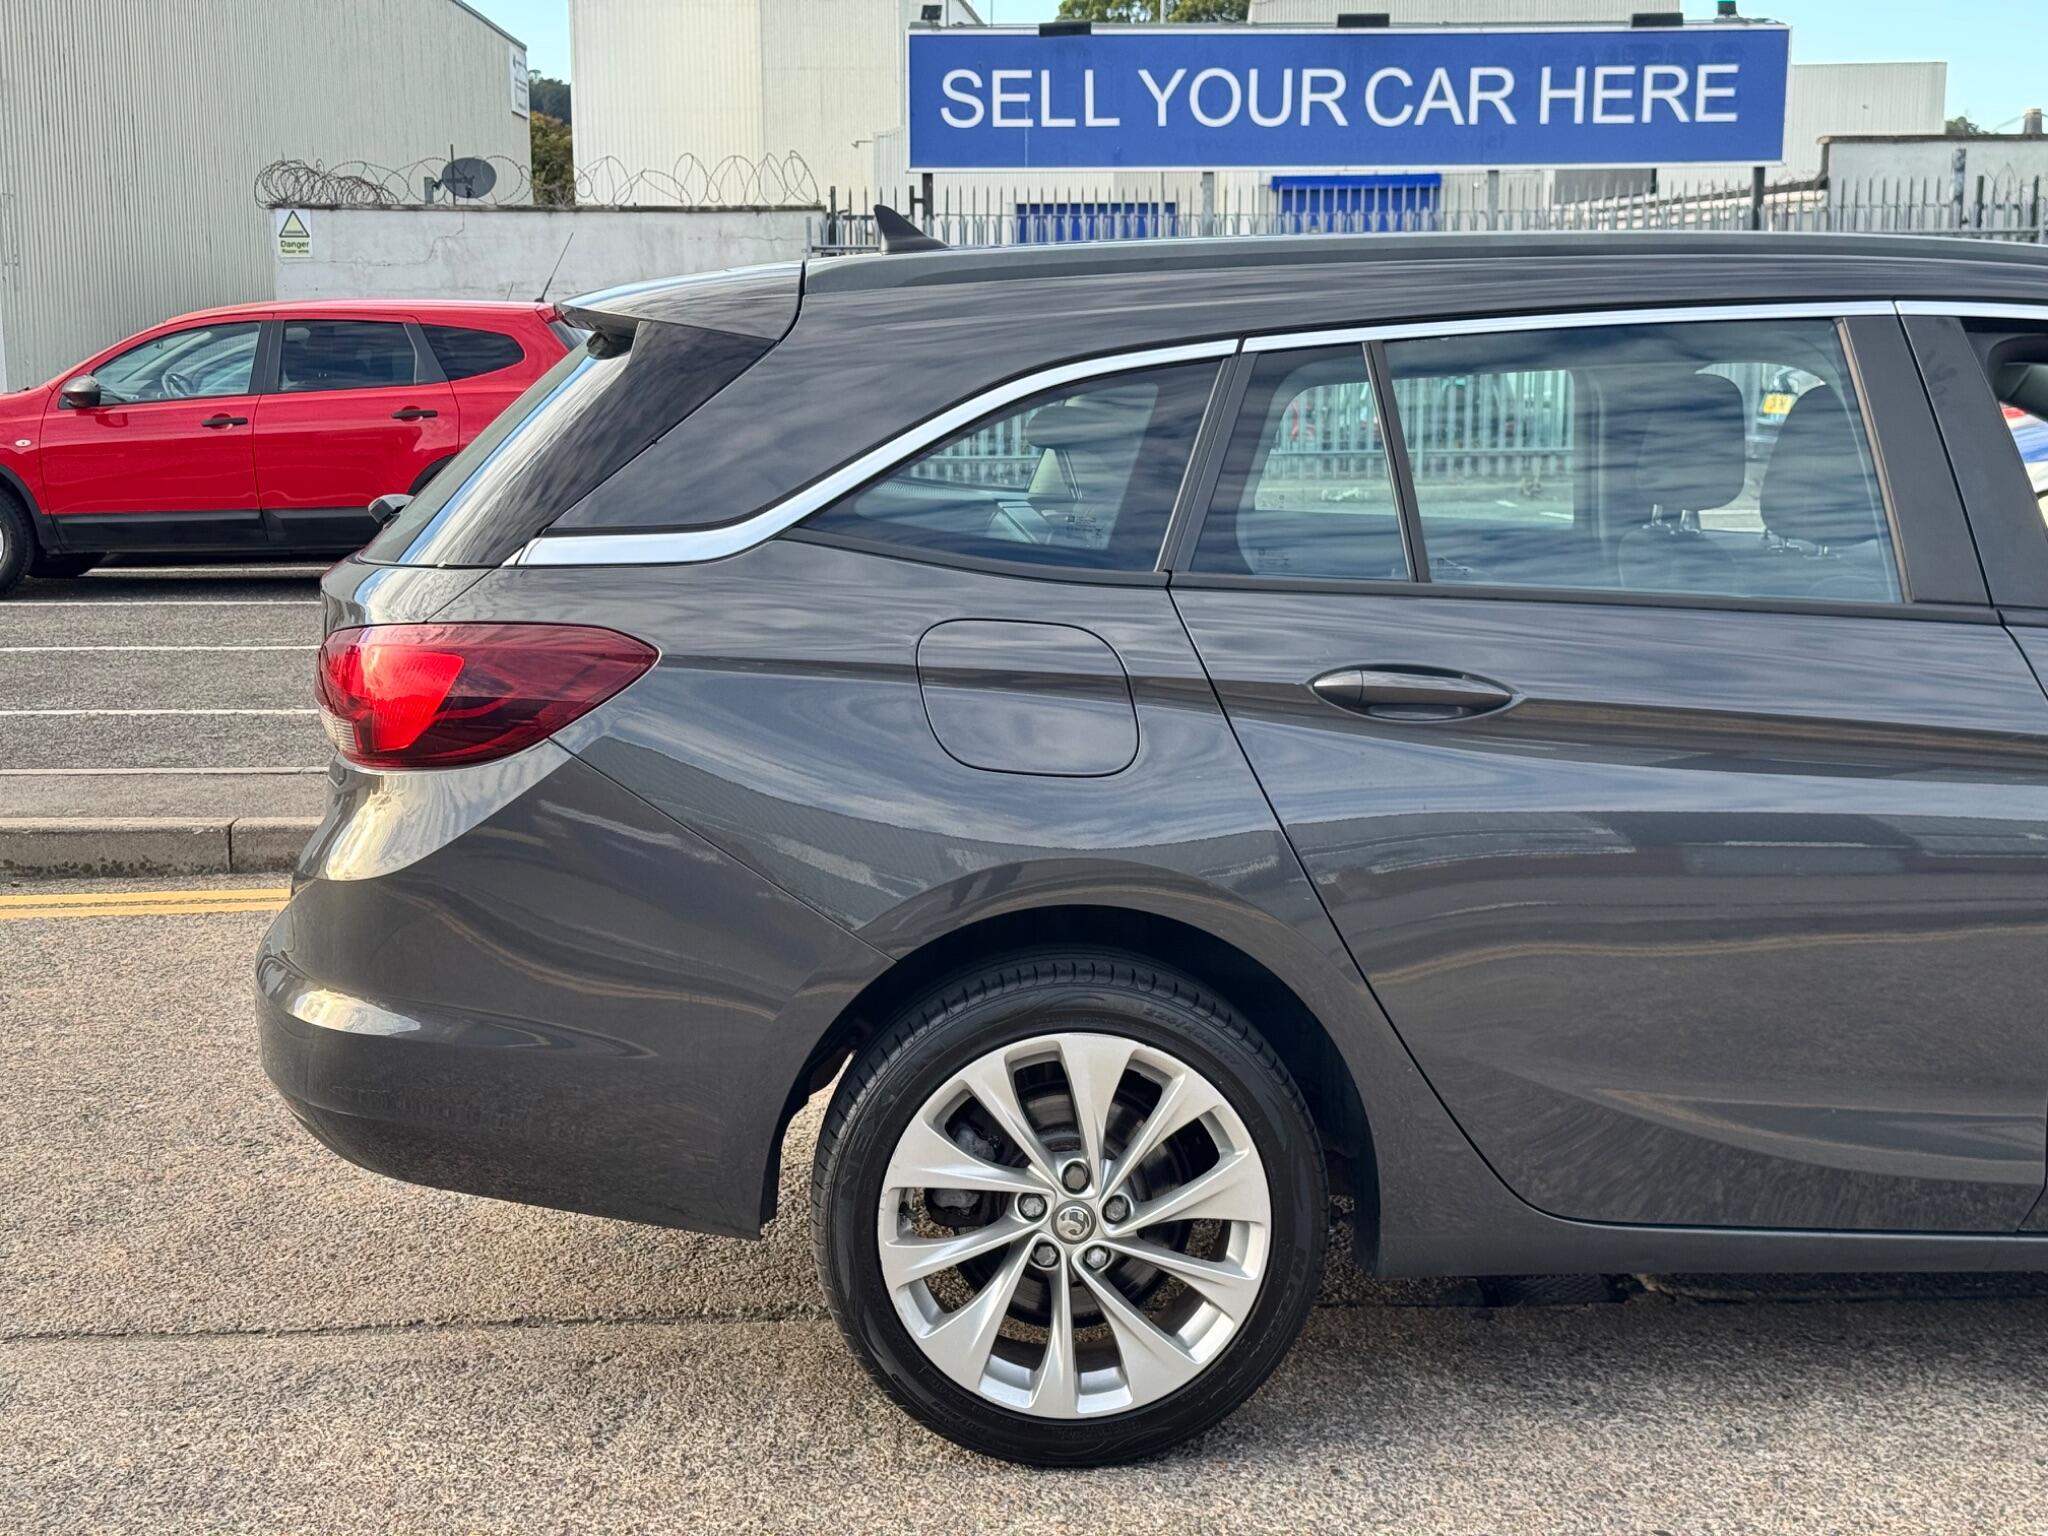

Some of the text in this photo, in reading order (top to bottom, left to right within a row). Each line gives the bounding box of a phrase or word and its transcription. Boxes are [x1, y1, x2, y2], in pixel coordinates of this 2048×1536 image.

[940, 63, 1740, 128] SELL YOUR CAR HERE
[280, 240, 309, 249] Danger
